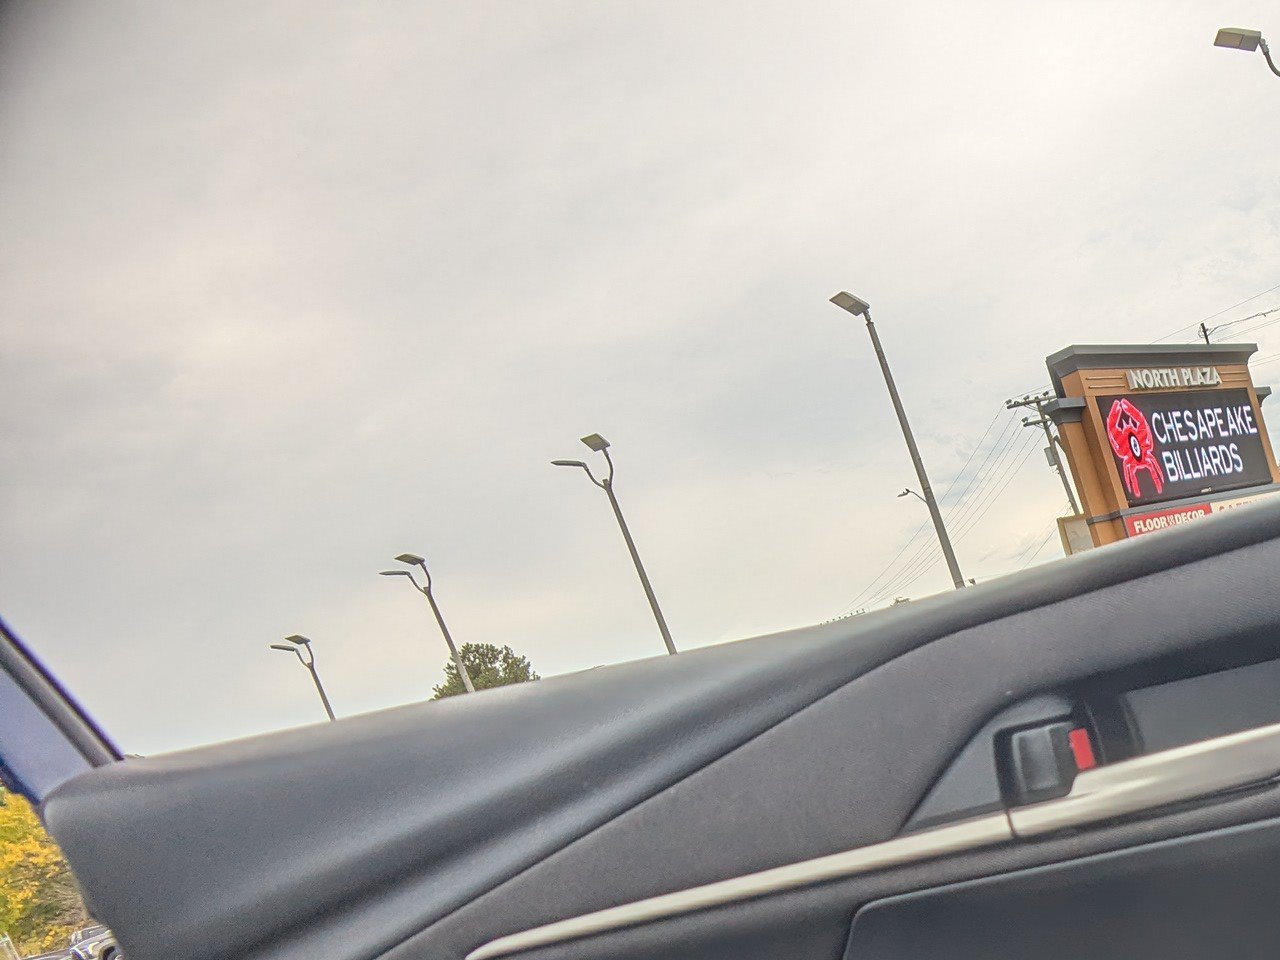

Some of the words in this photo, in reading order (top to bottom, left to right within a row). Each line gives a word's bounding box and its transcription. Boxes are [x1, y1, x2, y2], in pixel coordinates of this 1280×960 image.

[1128, 368, 1180, 388] NORTH
[1181, 366, 1223, 386] PLAZA
[1151, 405, 1258, 444] CHESAPEAKE
[1162, 443, 1243, 482] BILLIARDS
[1133, 515, 1169, 534] FLOOR
[1174, 509, 1206, 525] DECOR
